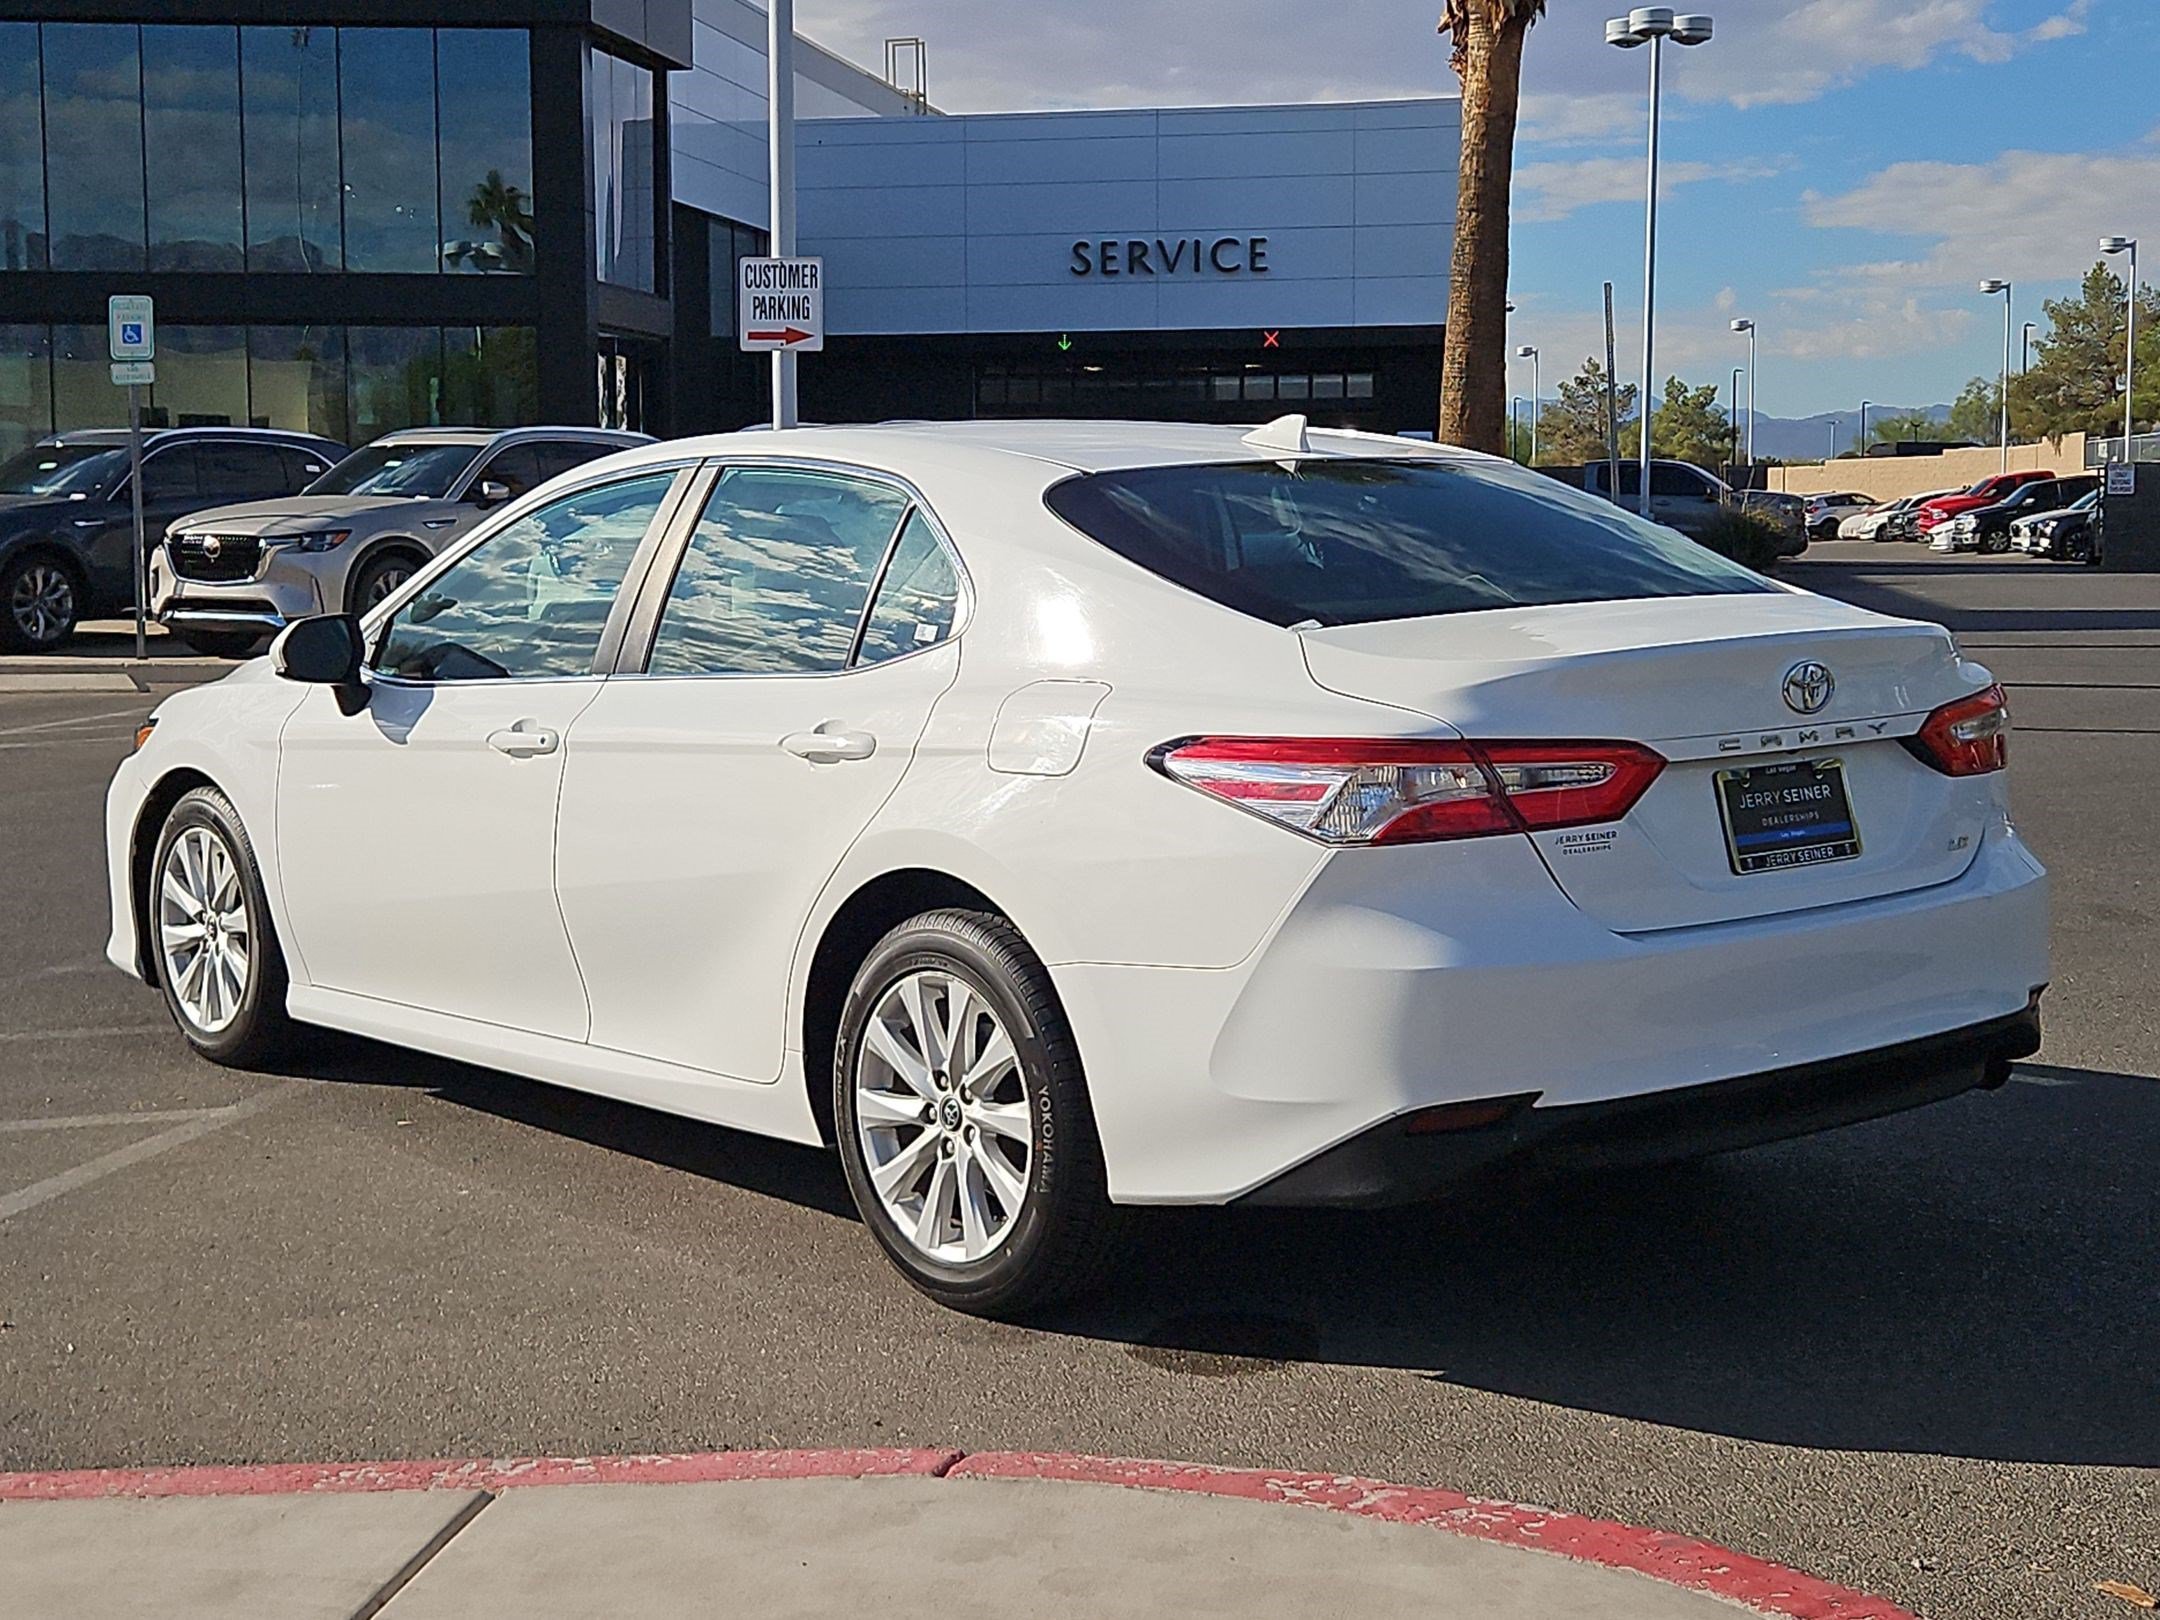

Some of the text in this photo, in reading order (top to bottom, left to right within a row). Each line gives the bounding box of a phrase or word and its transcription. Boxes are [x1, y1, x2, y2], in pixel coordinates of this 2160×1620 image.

[1070, 236, 1268, 276] SERVICE
[744, 263, 819, 289] CUSTOMER
[752, 295, 811, 321] PARKING
[1719, 721, 1888, 752] CAMRY
[1739, 784, 1832, 809] JERRY SEINER
[1761, 811, 1820, 826] DEALERSHIPS
[1555, 830, 1617, 845] JERRY SEINER
[1562, 844, 1612, 855] DEALERSHIPS
[1765, 847, 1834, 867] JERRY SEINER
[1038, 1084, 1054, 1193] YOKOHAMA
